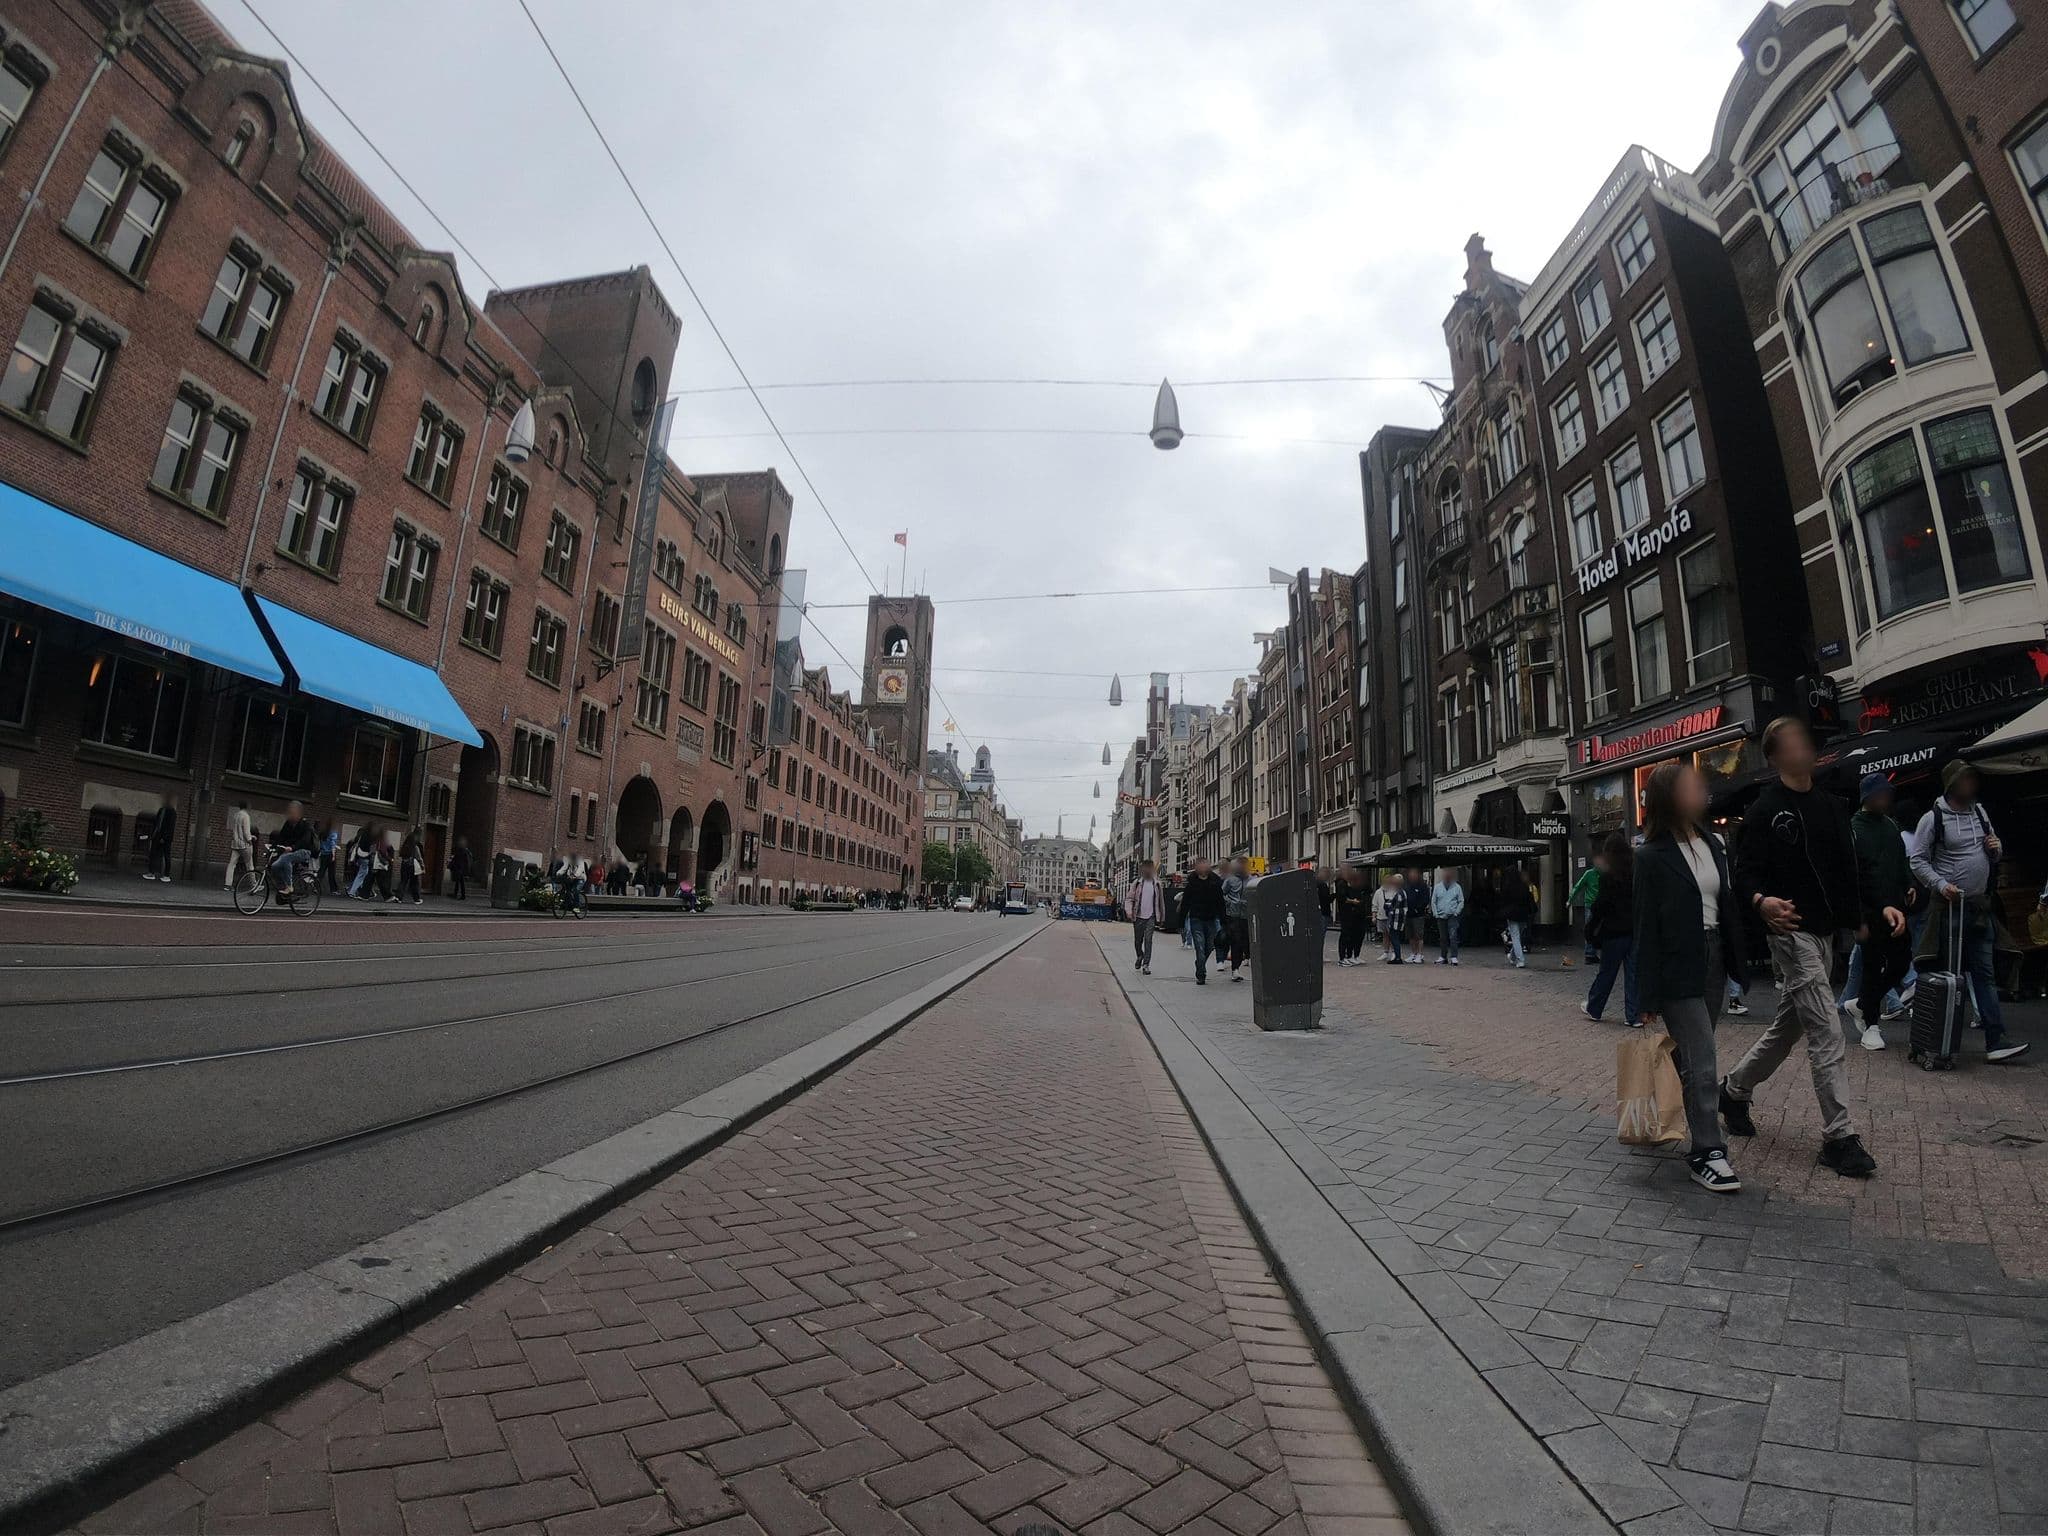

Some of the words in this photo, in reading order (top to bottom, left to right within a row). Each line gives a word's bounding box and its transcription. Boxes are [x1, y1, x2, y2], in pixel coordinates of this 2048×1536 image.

[1578, 547, 1619, 595] Hotel
[1624, 505, 1692, 567] Manofa
[95, 611, 117, 629] THE
[120, 620, 168, 646] SEAFOOD
[171, 638, 191, 655] BAR
[660, 592, 689, 627] BEURS
[691, 616, 707, 641] VAN
[708, 631, 739, 665] BERLAGE
[1925, 667, 1977, 697] GRILL
[1900, 674, 2017, 723] RESTAURANT
[1860, 747, 1937, 775] RESTAURANT
[1123, 795, 1154, 807] CASINO
[1532, 822, 1567, 836] Manofa
[1541, 817, 1558, 826] Hotel
[1446, 845, 1475, 853] LUNCH
[1476, 845, 1483, 853] &
[1484, 845, 1535, 853] STEAKHOUSE
